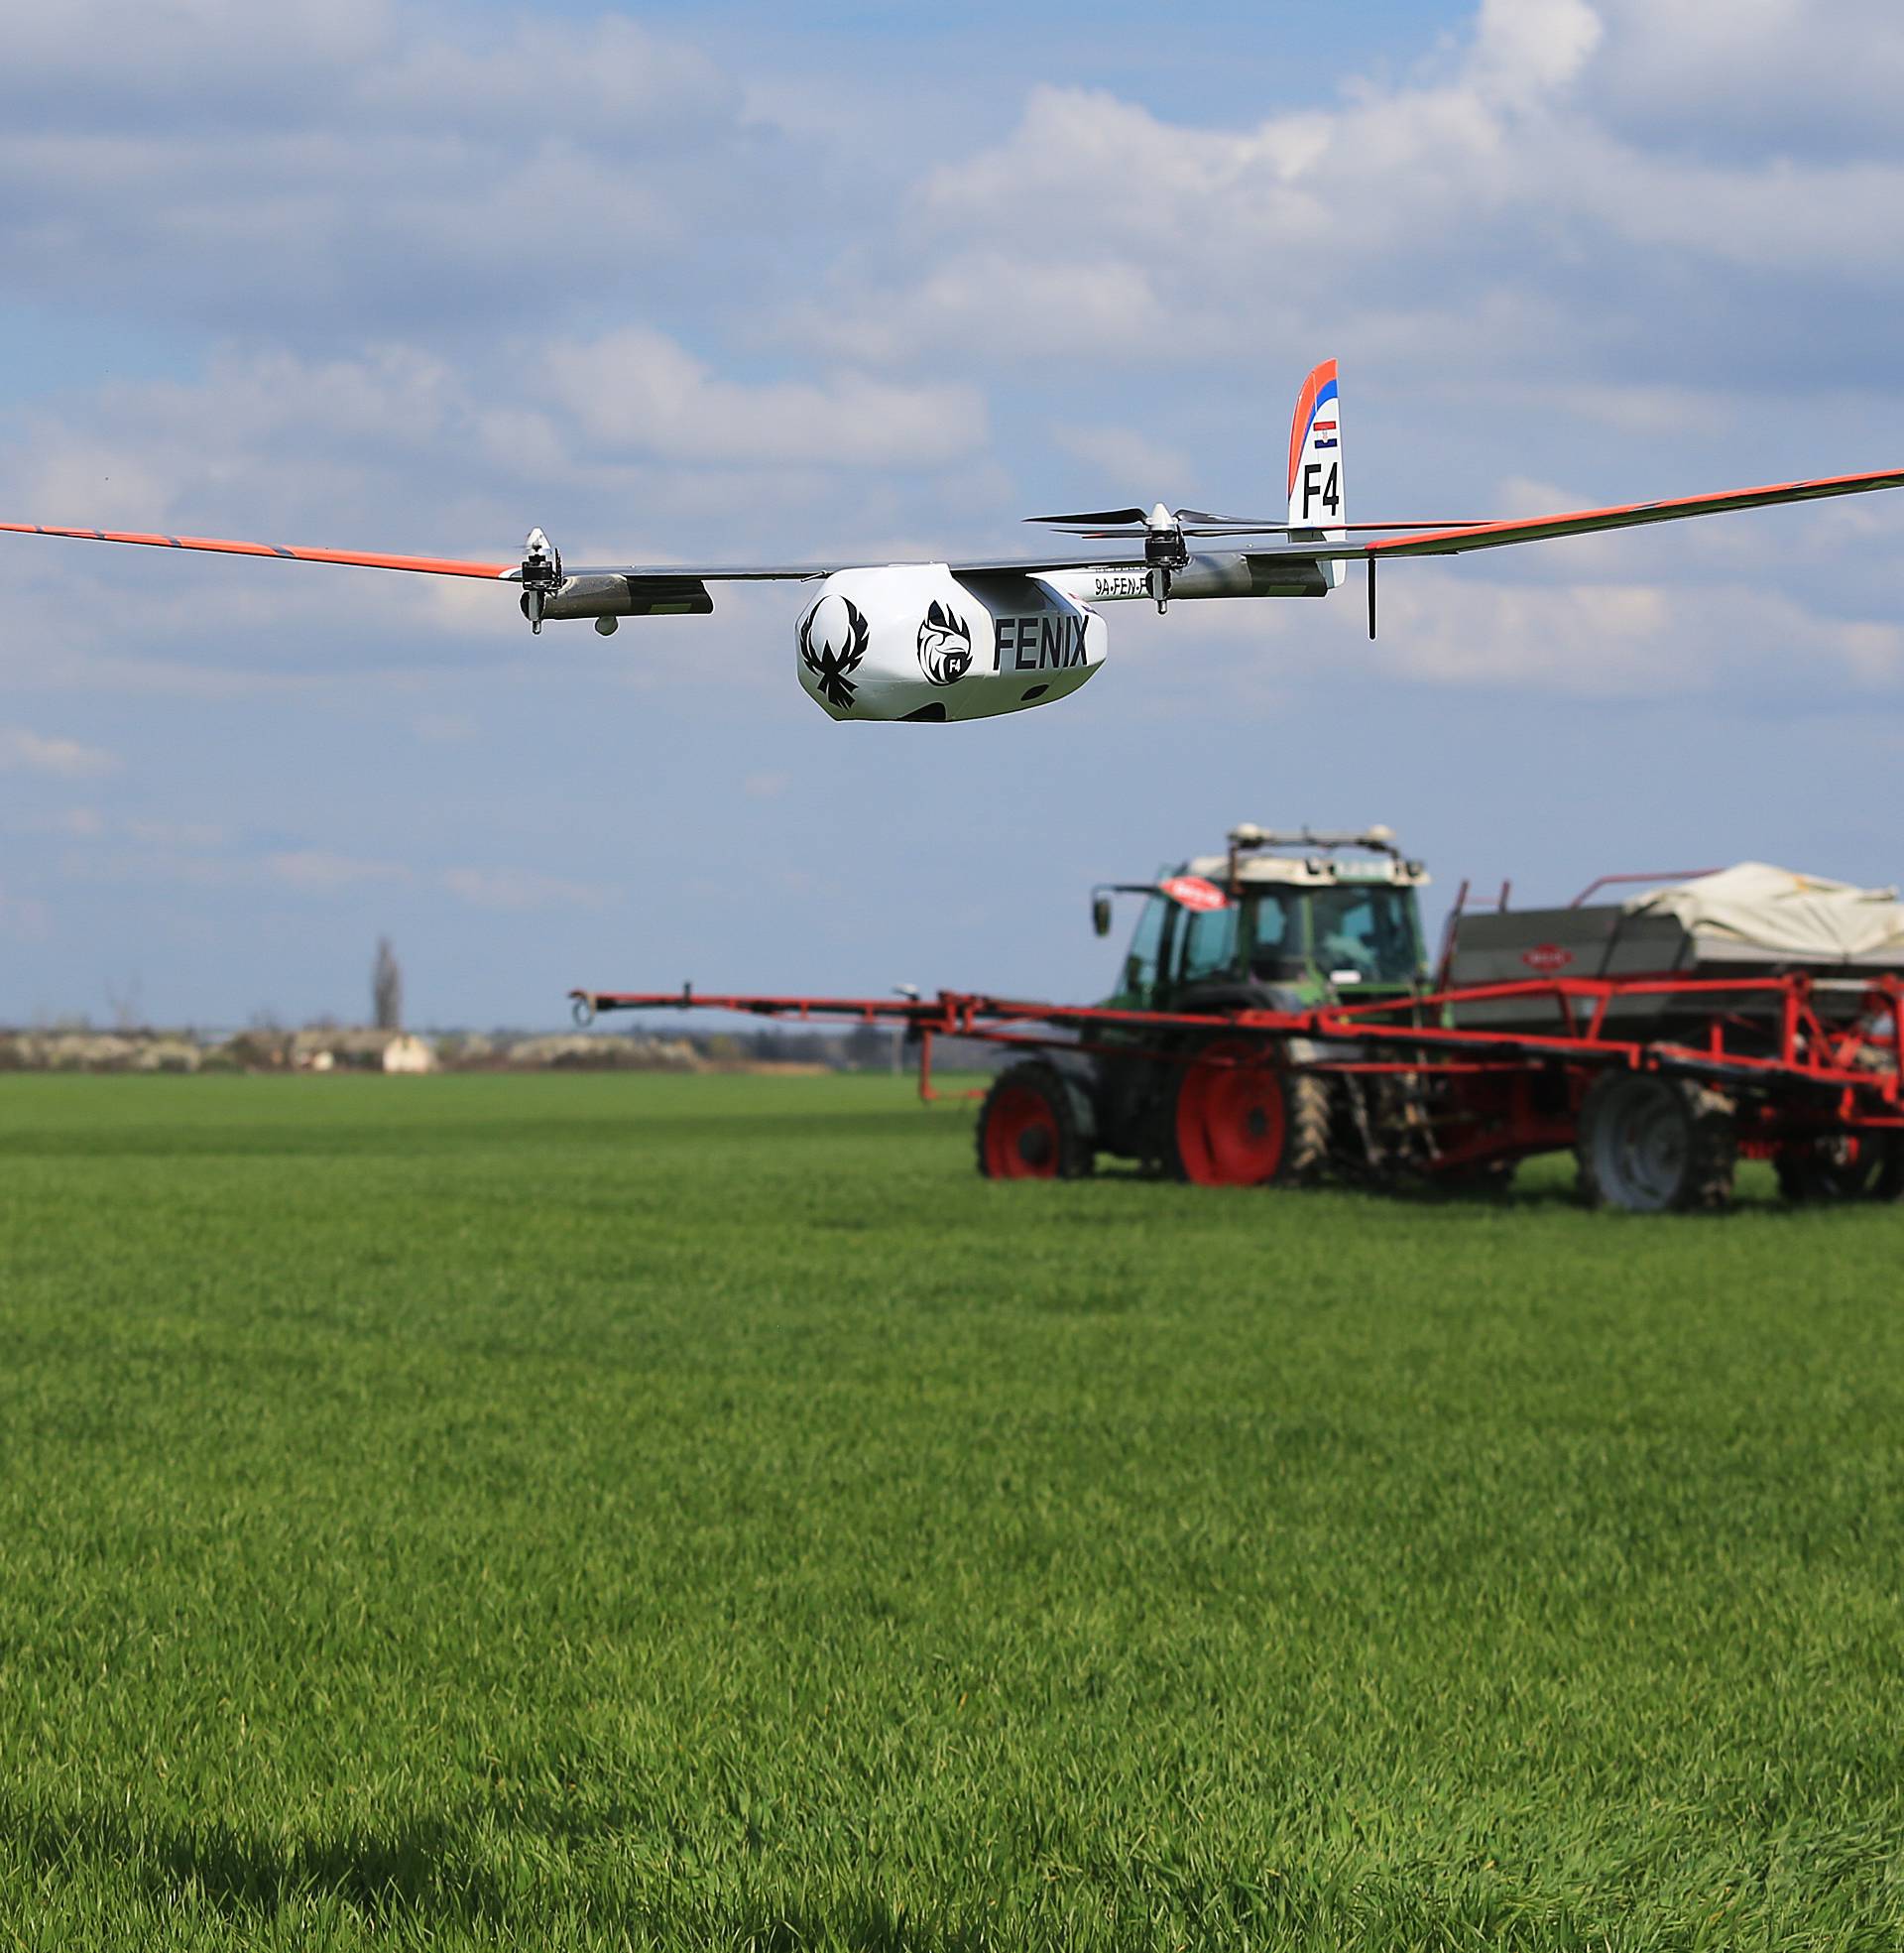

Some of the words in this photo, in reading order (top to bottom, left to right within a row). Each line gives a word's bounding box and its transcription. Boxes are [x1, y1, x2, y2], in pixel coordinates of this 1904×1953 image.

[1303, 462, 1339, 519] F4
[949, 659, 961, 672] F4
[993, 615, 1089, 671] FENIX
